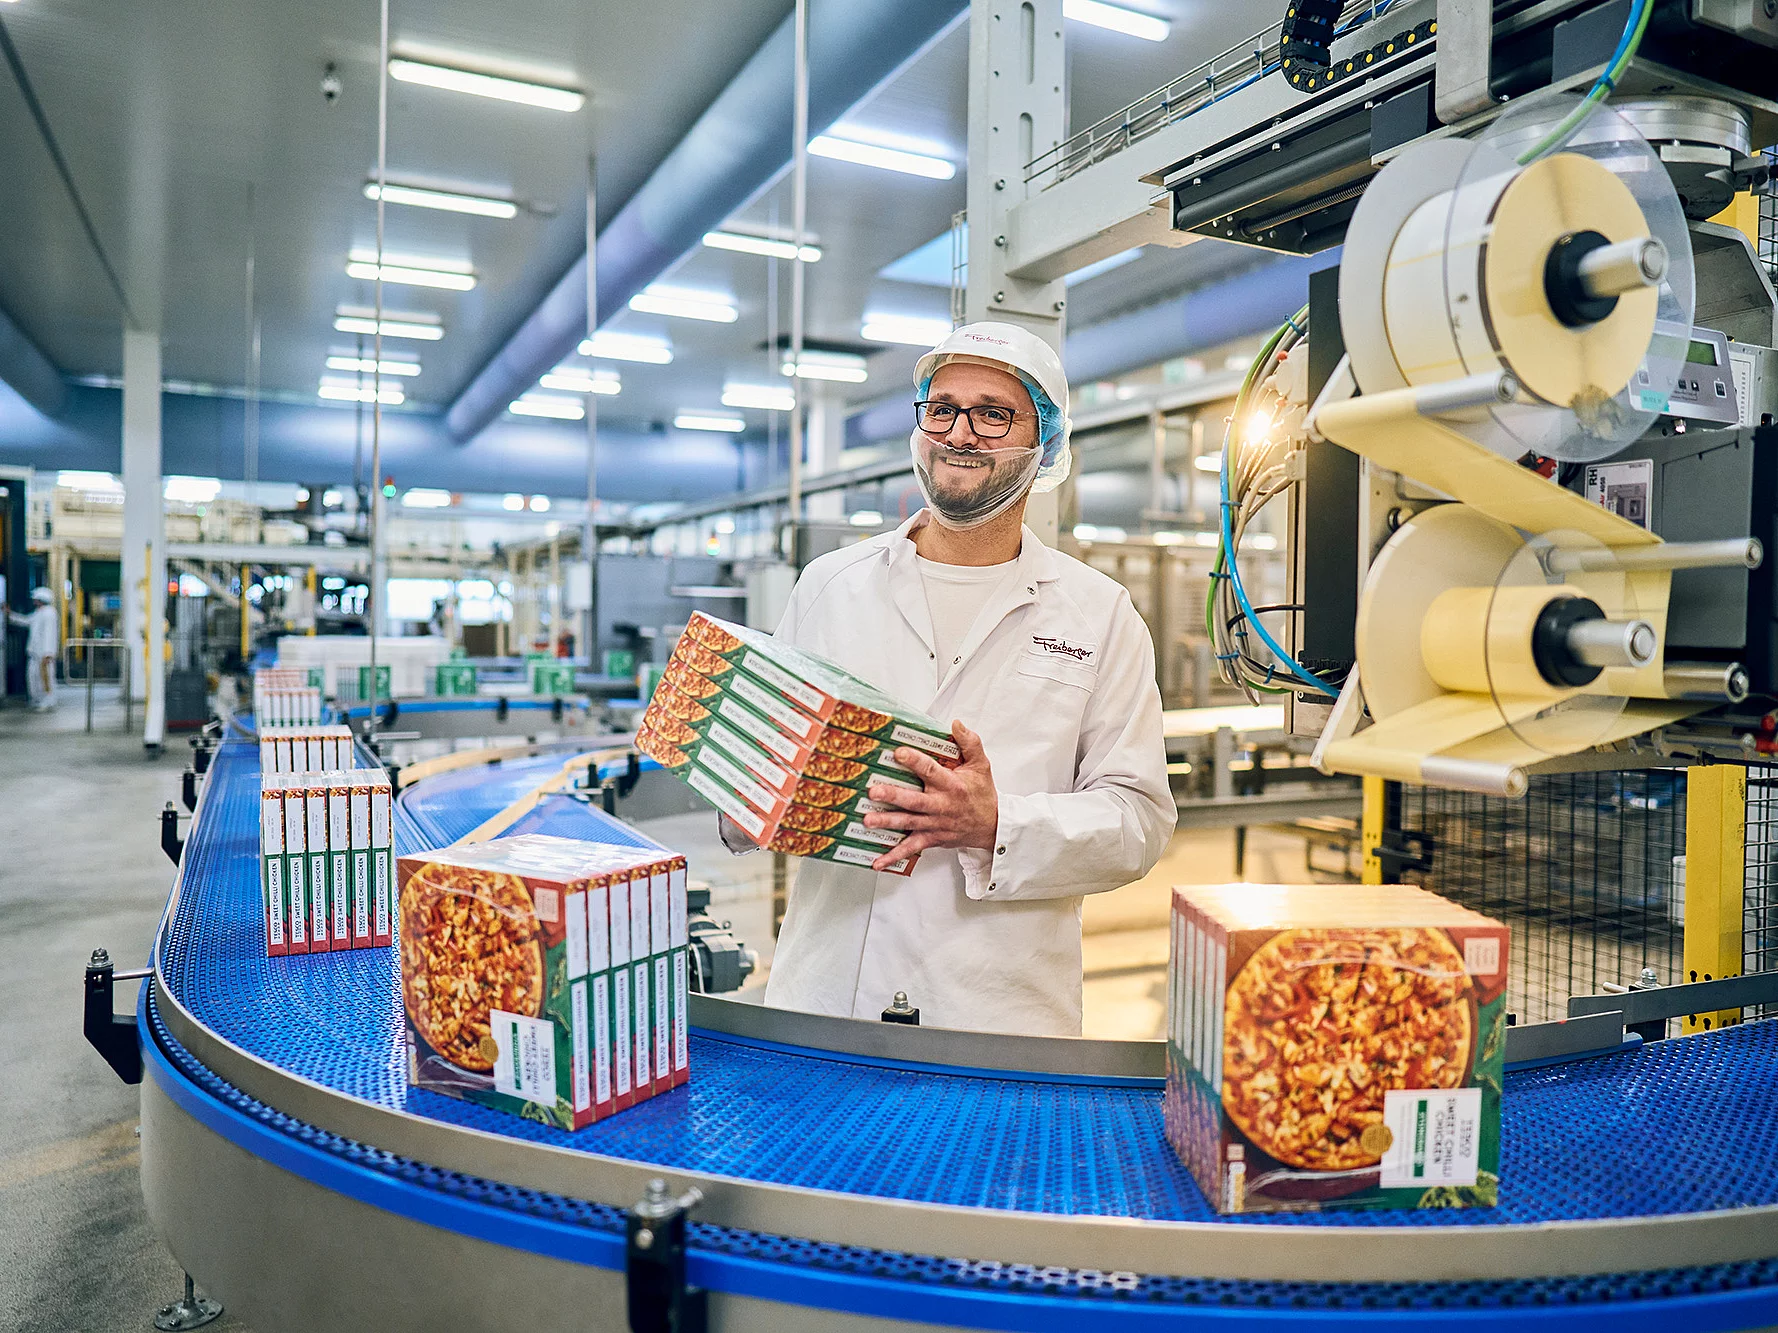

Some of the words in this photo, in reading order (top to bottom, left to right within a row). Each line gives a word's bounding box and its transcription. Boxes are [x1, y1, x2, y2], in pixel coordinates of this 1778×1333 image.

[1589, 469, 1598, 486] RH
[1032, 636, 1093, 660] Freiberger
[896, 730, 916, 741] CHICKEN
[915, 736, 930, 746] CHILLI
[928, 740, 943, 750] SWEET
[943, 743, 958, 755] TESCO
[849, 826, 870, 837] CHICKEN
[869, 831, 885, 840] CHILLI
[883, 834, 899, 844] SWEET
